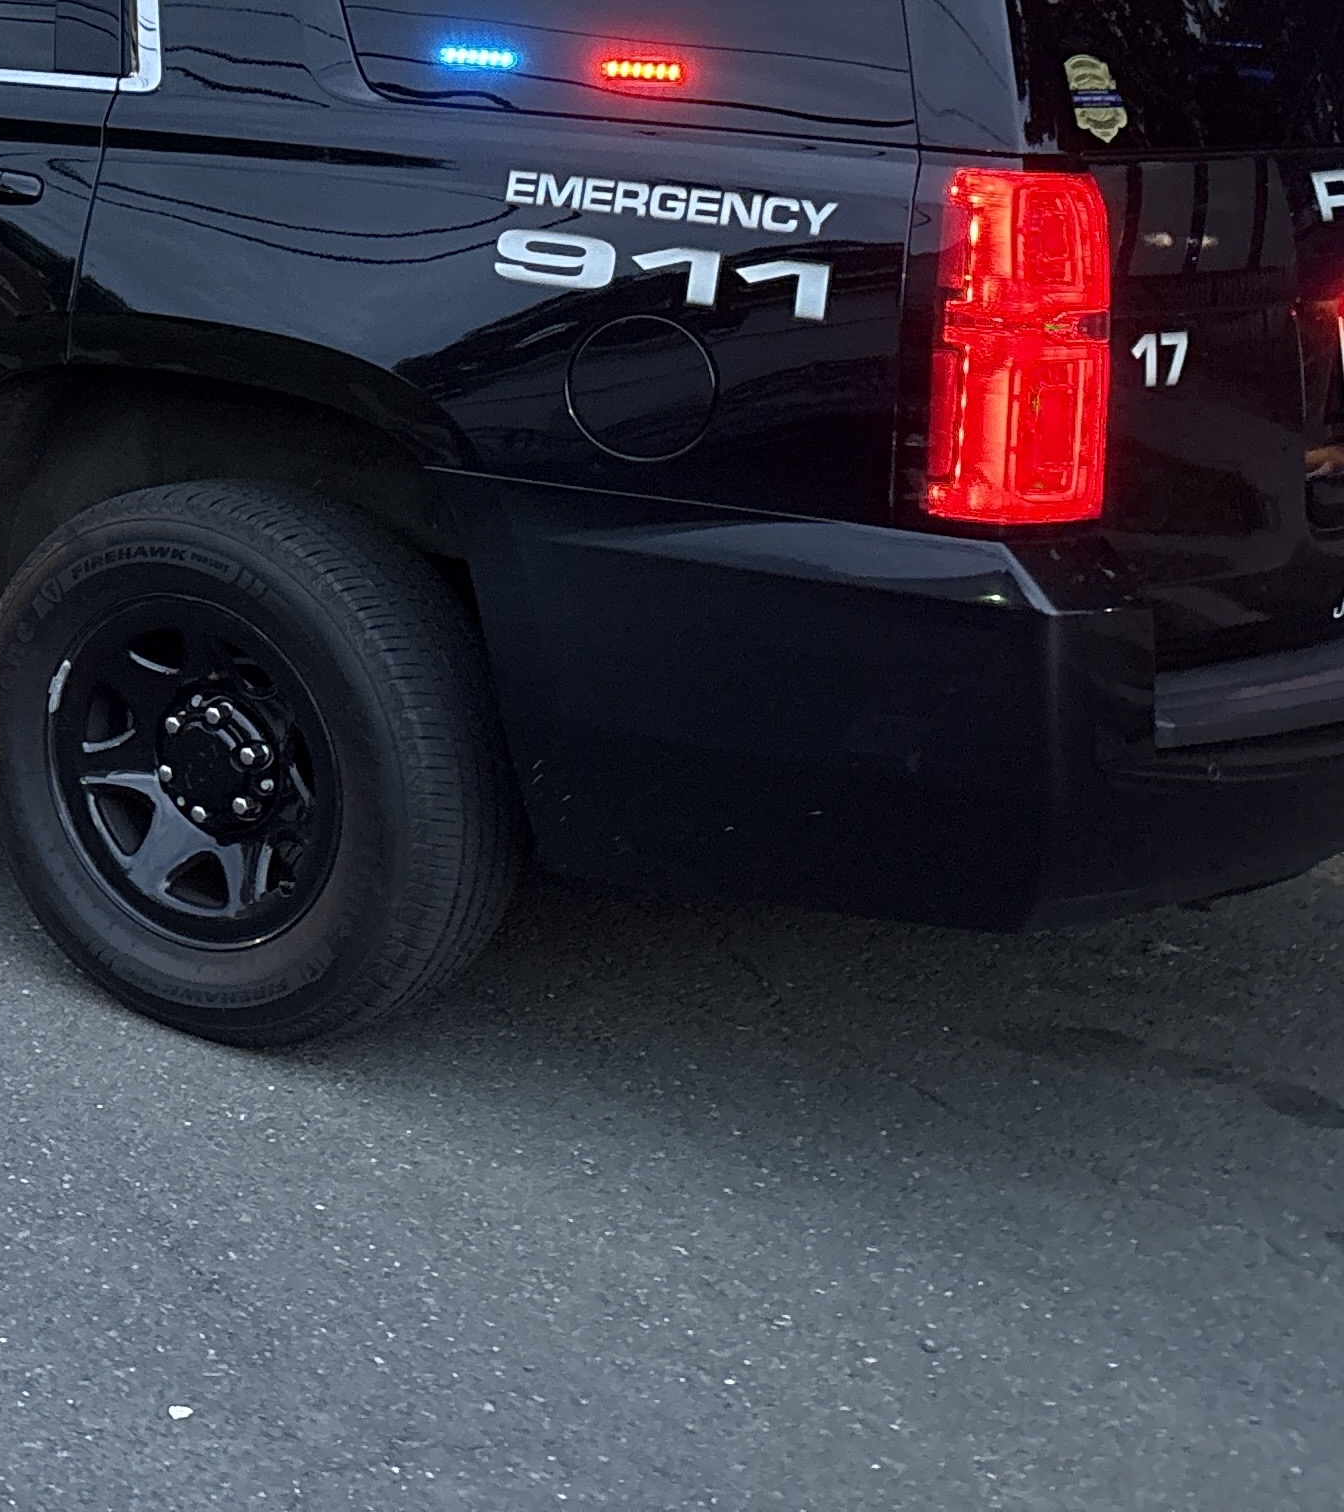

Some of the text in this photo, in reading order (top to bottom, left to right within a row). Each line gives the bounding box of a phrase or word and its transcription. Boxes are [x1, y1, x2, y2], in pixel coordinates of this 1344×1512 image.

[505, 170, 839, 236] EMERGENCY
[494, 228, 832, 322] 911
[1131, 331, 1190, 388] 17
[70, 544, 188, 581] FIREHAWK
